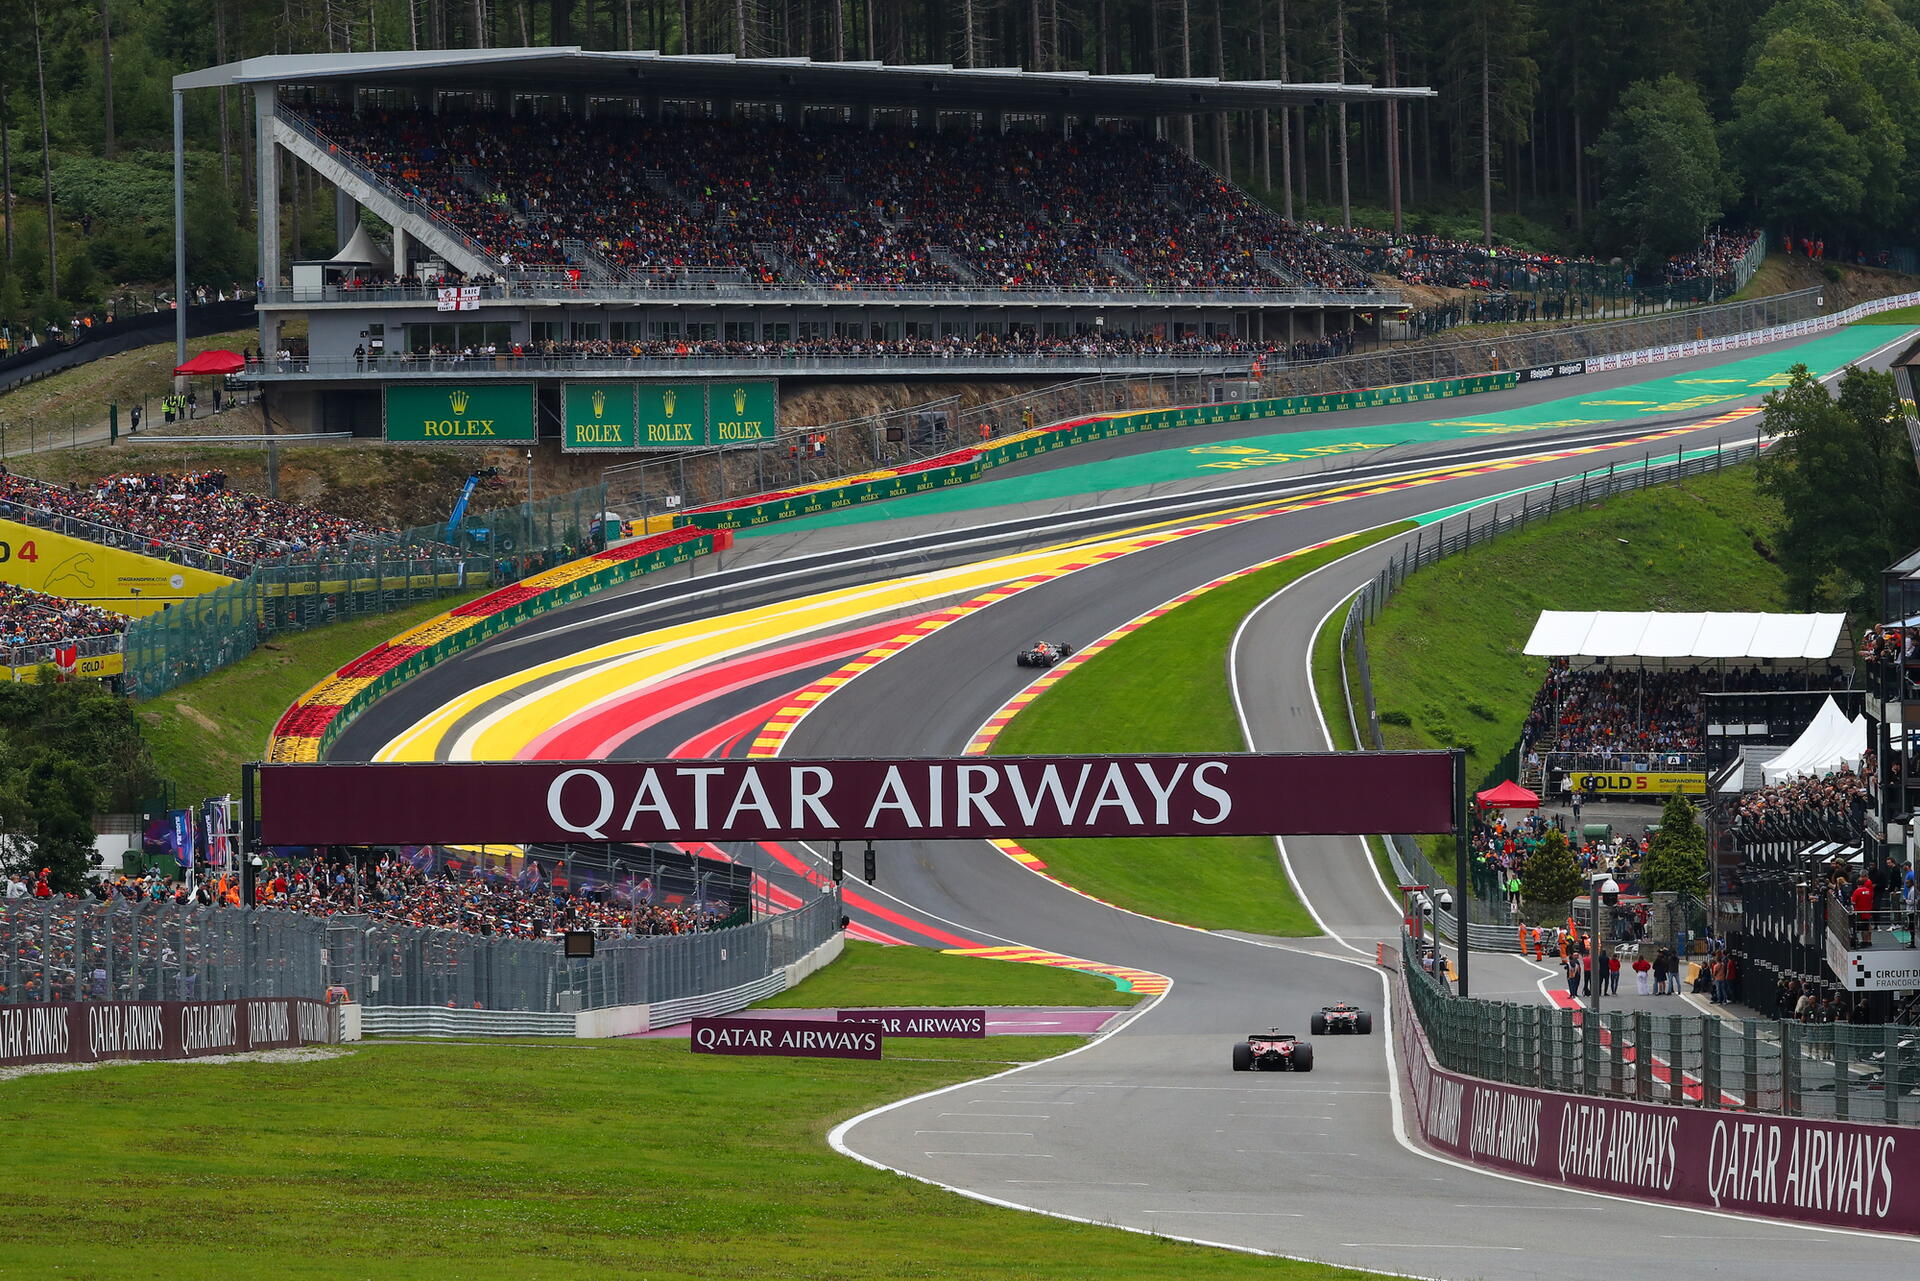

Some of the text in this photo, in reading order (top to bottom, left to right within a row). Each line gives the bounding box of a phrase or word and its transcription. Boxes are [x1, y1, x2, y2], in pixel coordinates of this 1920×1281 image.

[424, 420, 495, 436] ROLEX
[575, 425, 622, 442] ROLEX
[648, 424, 694, 442] ROLEX
[718, 421, 761, 440] ROLEX
[18, 541, 38, 563] 4
[81, 661, 99, 673] GOLD
[1636, 776, 1648, 789] 5
[547, 761, 1232, 839] QATAR AIRWAYS
[1876, 970, 1910, 979] CIRCUIT
[26, 1007, 69, 1055] AIRWAYS
[89, 1005, 163, 1058] QATAR AIRWAYS
[181, 1004, 237, 1055] QATAR AIRWAYS
[248, 1001, 267, 1048] QATAR
[906, 1018, 981, 1032] AIRWAYS
[697, 1028, 875, 1051] QATAR AIRWAYS
[1469, 1086, 1542, 1167] QATAR AIRWAYS
[1558, 1101, 1678, 1191] QATAR AIRWAYS
[1707, 1119, 1896, 1218] QATAR AIRWAYS
